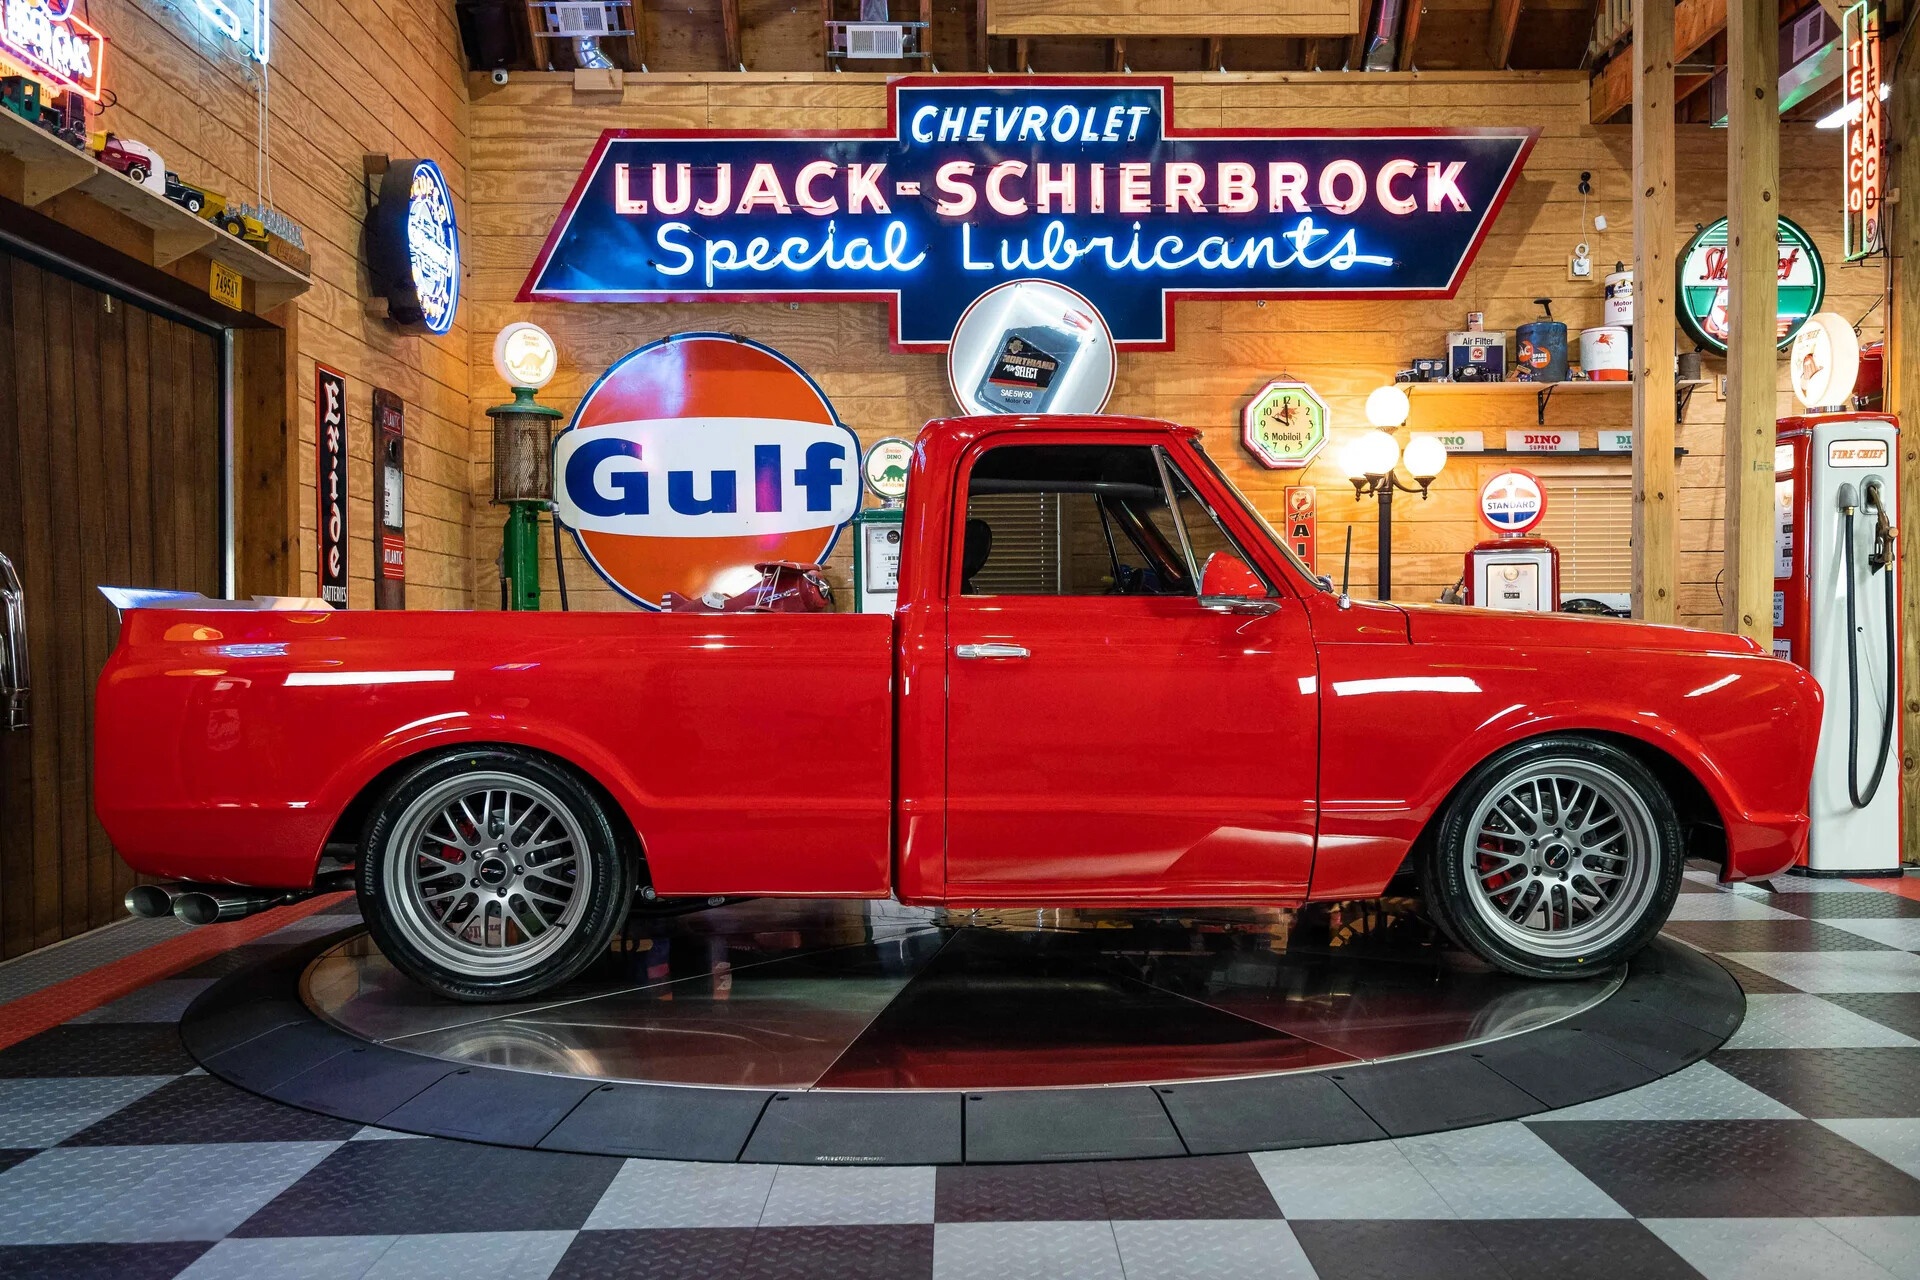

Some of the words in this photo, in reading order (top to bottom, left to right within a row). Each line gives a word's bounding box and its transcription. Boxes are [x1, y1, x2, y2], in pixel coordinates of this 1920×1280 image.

[911, 104, 1152, 143] CHEVROLET
[613, 159, 1472, 216] LUJACK-SCHIERBROCK
[654, 219, 930, 287] Special
[961, 216, 1395, 271] Lubricants
[1462, 337, 1473, 345] Air
[1474, 337, 1494, 345] Filter
[1518, 345, 1531, 356] AC
[1014, 365, 1039, 380] SELECT
[1000, 388, 1014, 398] SAE
[1013, 389, 1033, 400] 5W-30
[1283, 396, 1291, 405] 12
[1263, 408, 1272, 416] 10
[1305, 407, 1311, 416] 2
[1260, 420, 1266, 429] 9
[1308, 420, 1314, 429] 3
[1263, 432, 1269, 441] 8
[1271, 432, 1301, 441] Mobiloil
[1305, 432, 1311, 441] 4
[1438, 436, 1465, 445] INO
[1524, 435, 1561, 444] DINO
[1616, 435, 1632, 444] DI
[1272, 442, 1278, 450] 7
[1284, 444, 1290, 452] 6
[1297, 441, 1303, 449] 5
[323, 381, 342, 579] Exide
[565, 437, 846, 517] Gulf
[1487, 500, 1536, 510] STANDARD
[1288, 511, 1314, 522] Free
[383, 548, 403, 565] ATLANTIC
[322, 585, 347, 602] BATTERIES
